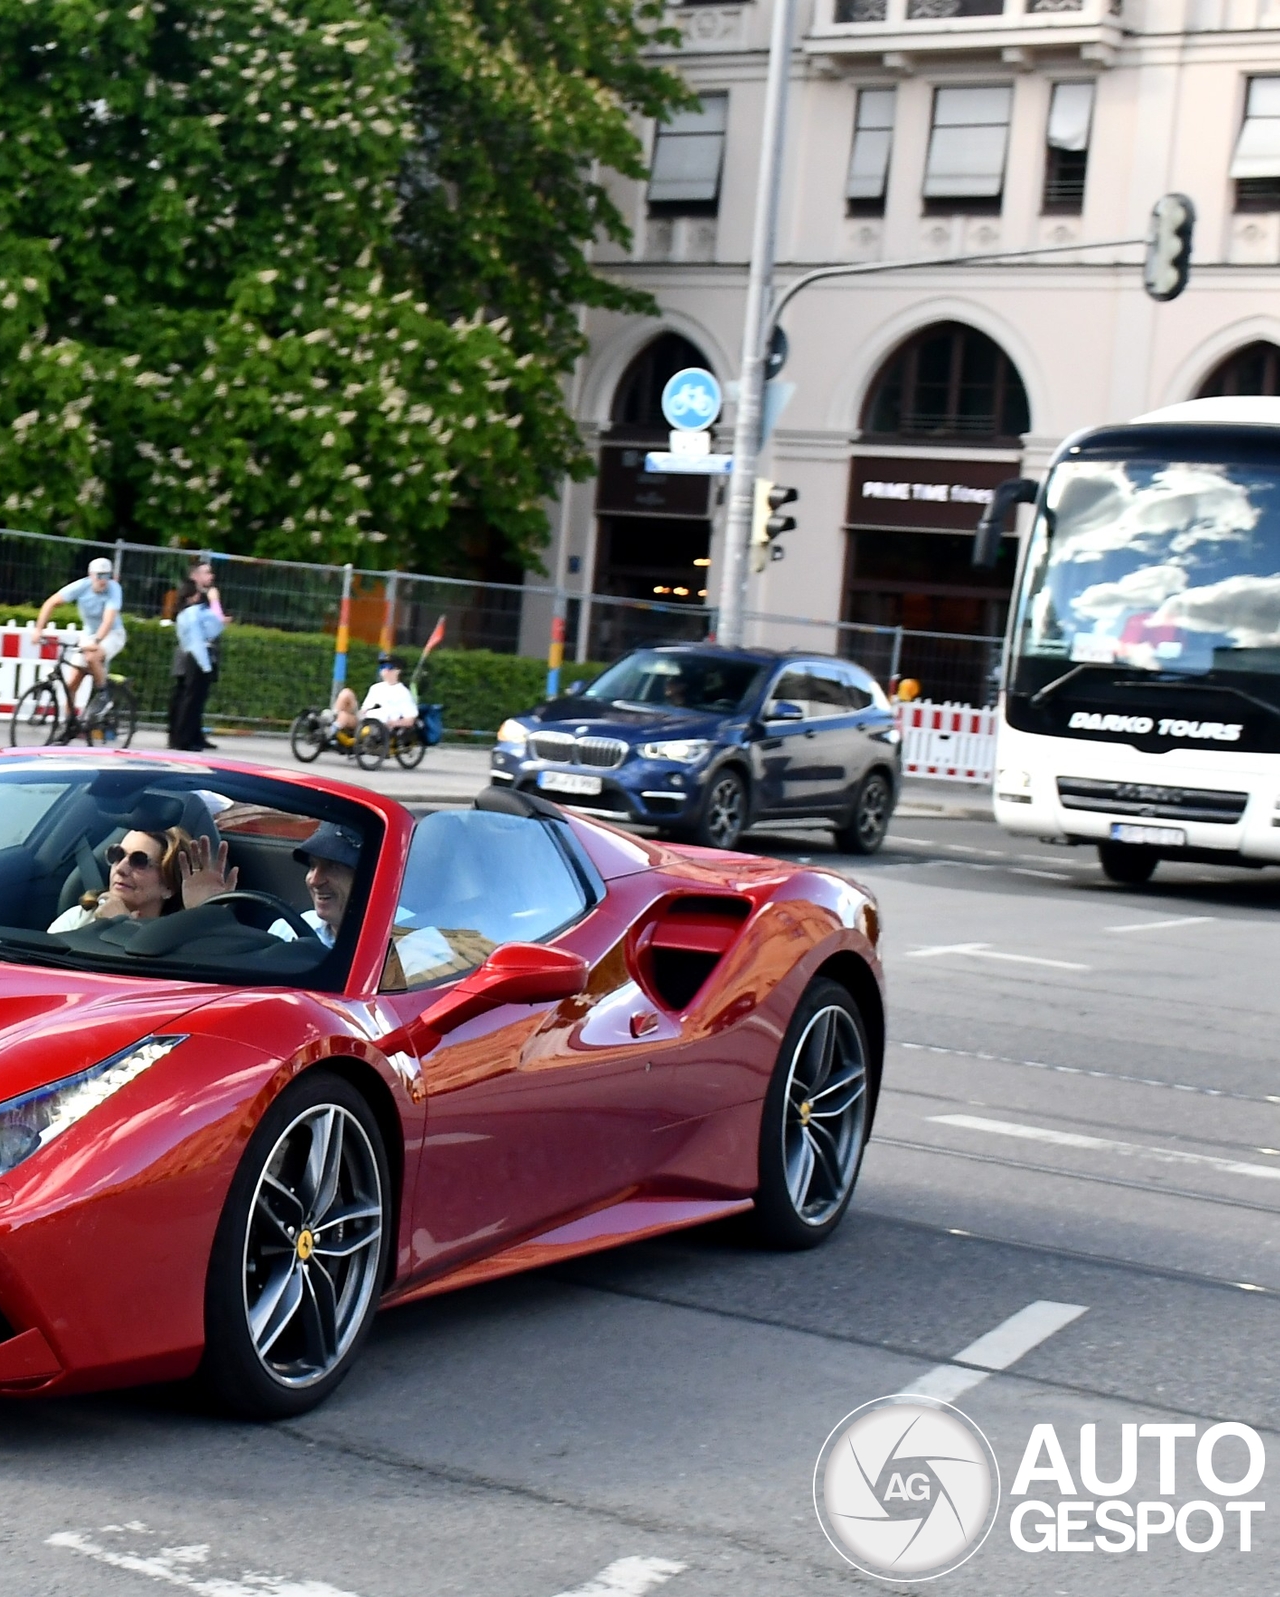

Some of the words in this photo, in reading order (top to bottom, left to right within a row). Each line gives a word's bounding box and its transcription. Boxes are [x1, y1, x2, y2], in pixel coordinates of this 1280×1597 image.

[862, 481, 910, 500] PRIME
[912, 483, 950, 502] TIME
[1068, 712, 1154, 734] DARKO
[1158, 719, 1244, 741] TOURS
